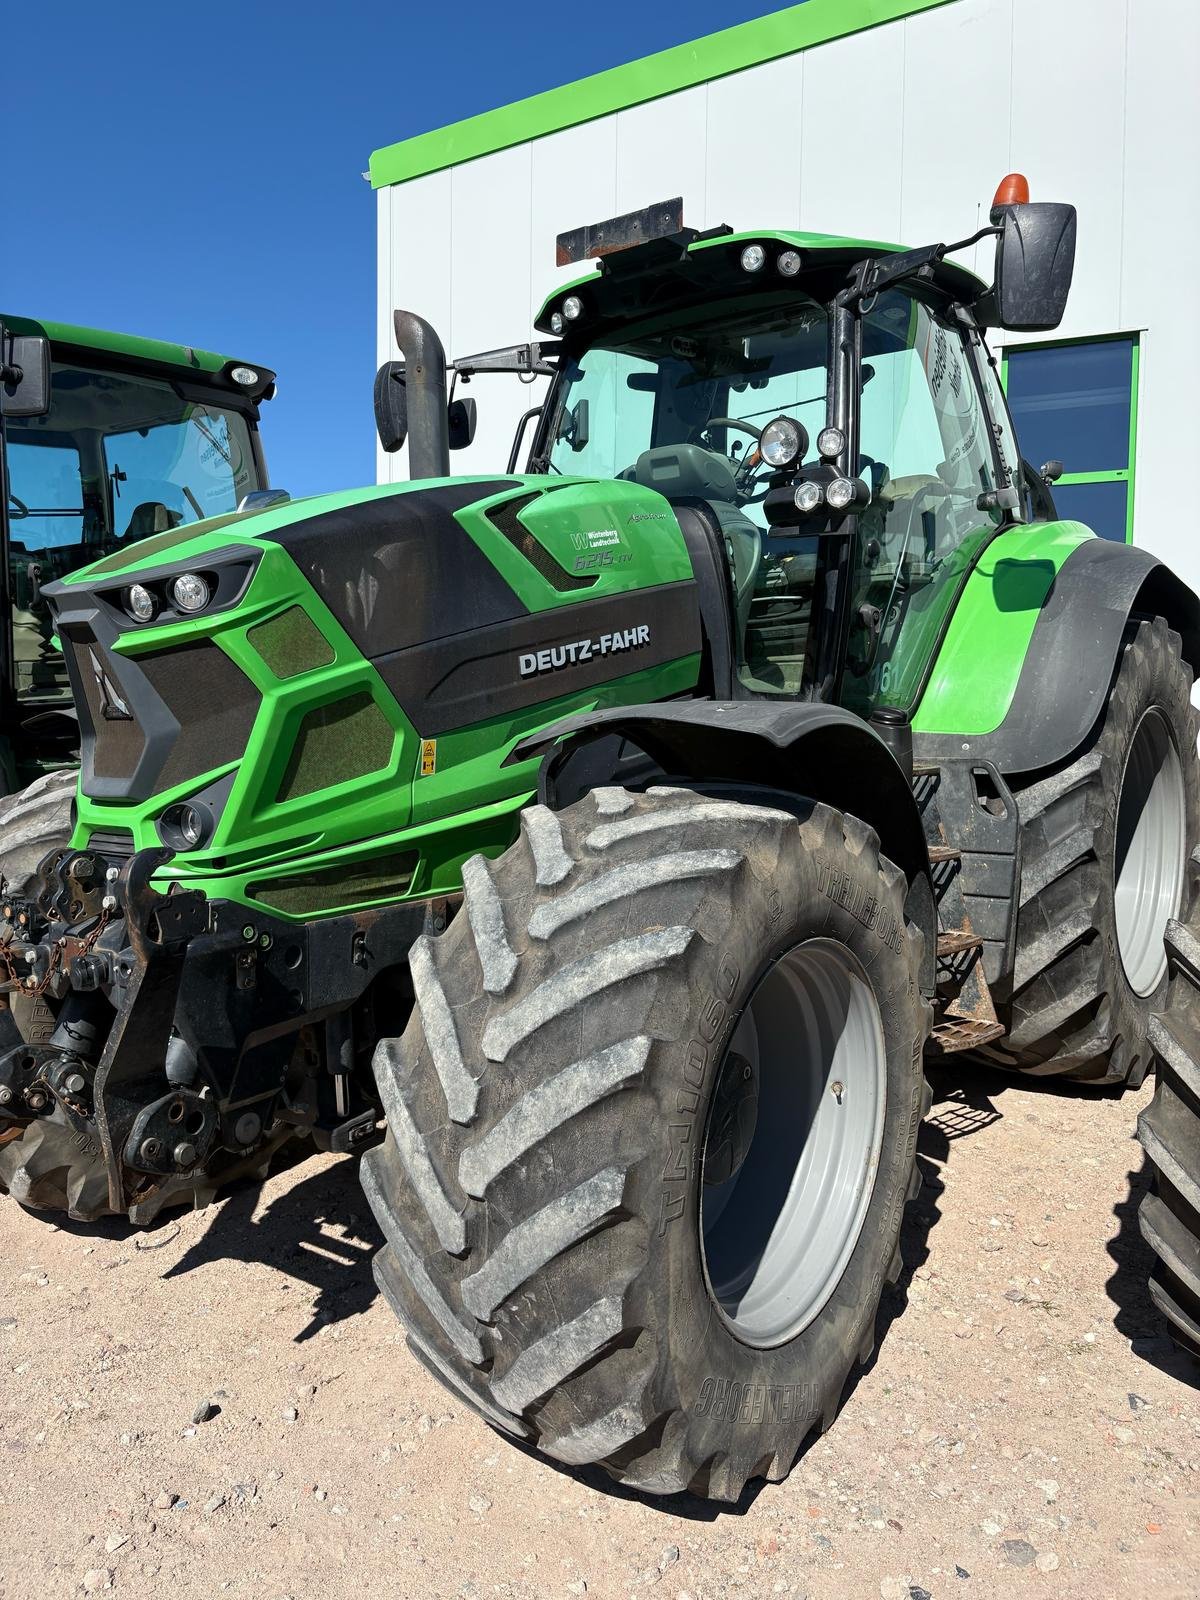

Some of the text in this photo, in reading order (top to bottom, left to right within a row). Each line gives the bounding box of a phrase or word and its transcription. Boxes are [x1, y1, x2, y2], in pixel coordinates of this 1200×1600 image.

[574, 550, 613, 571] 6215
[589, 537, 620, 548] Landtechnik
[518, 624, 650, 678] DEUTZ-FAHR
[816, 855, 905, 955] TRELLEBORG
[693, 1376, 820, 1424] TRELLEBORG
